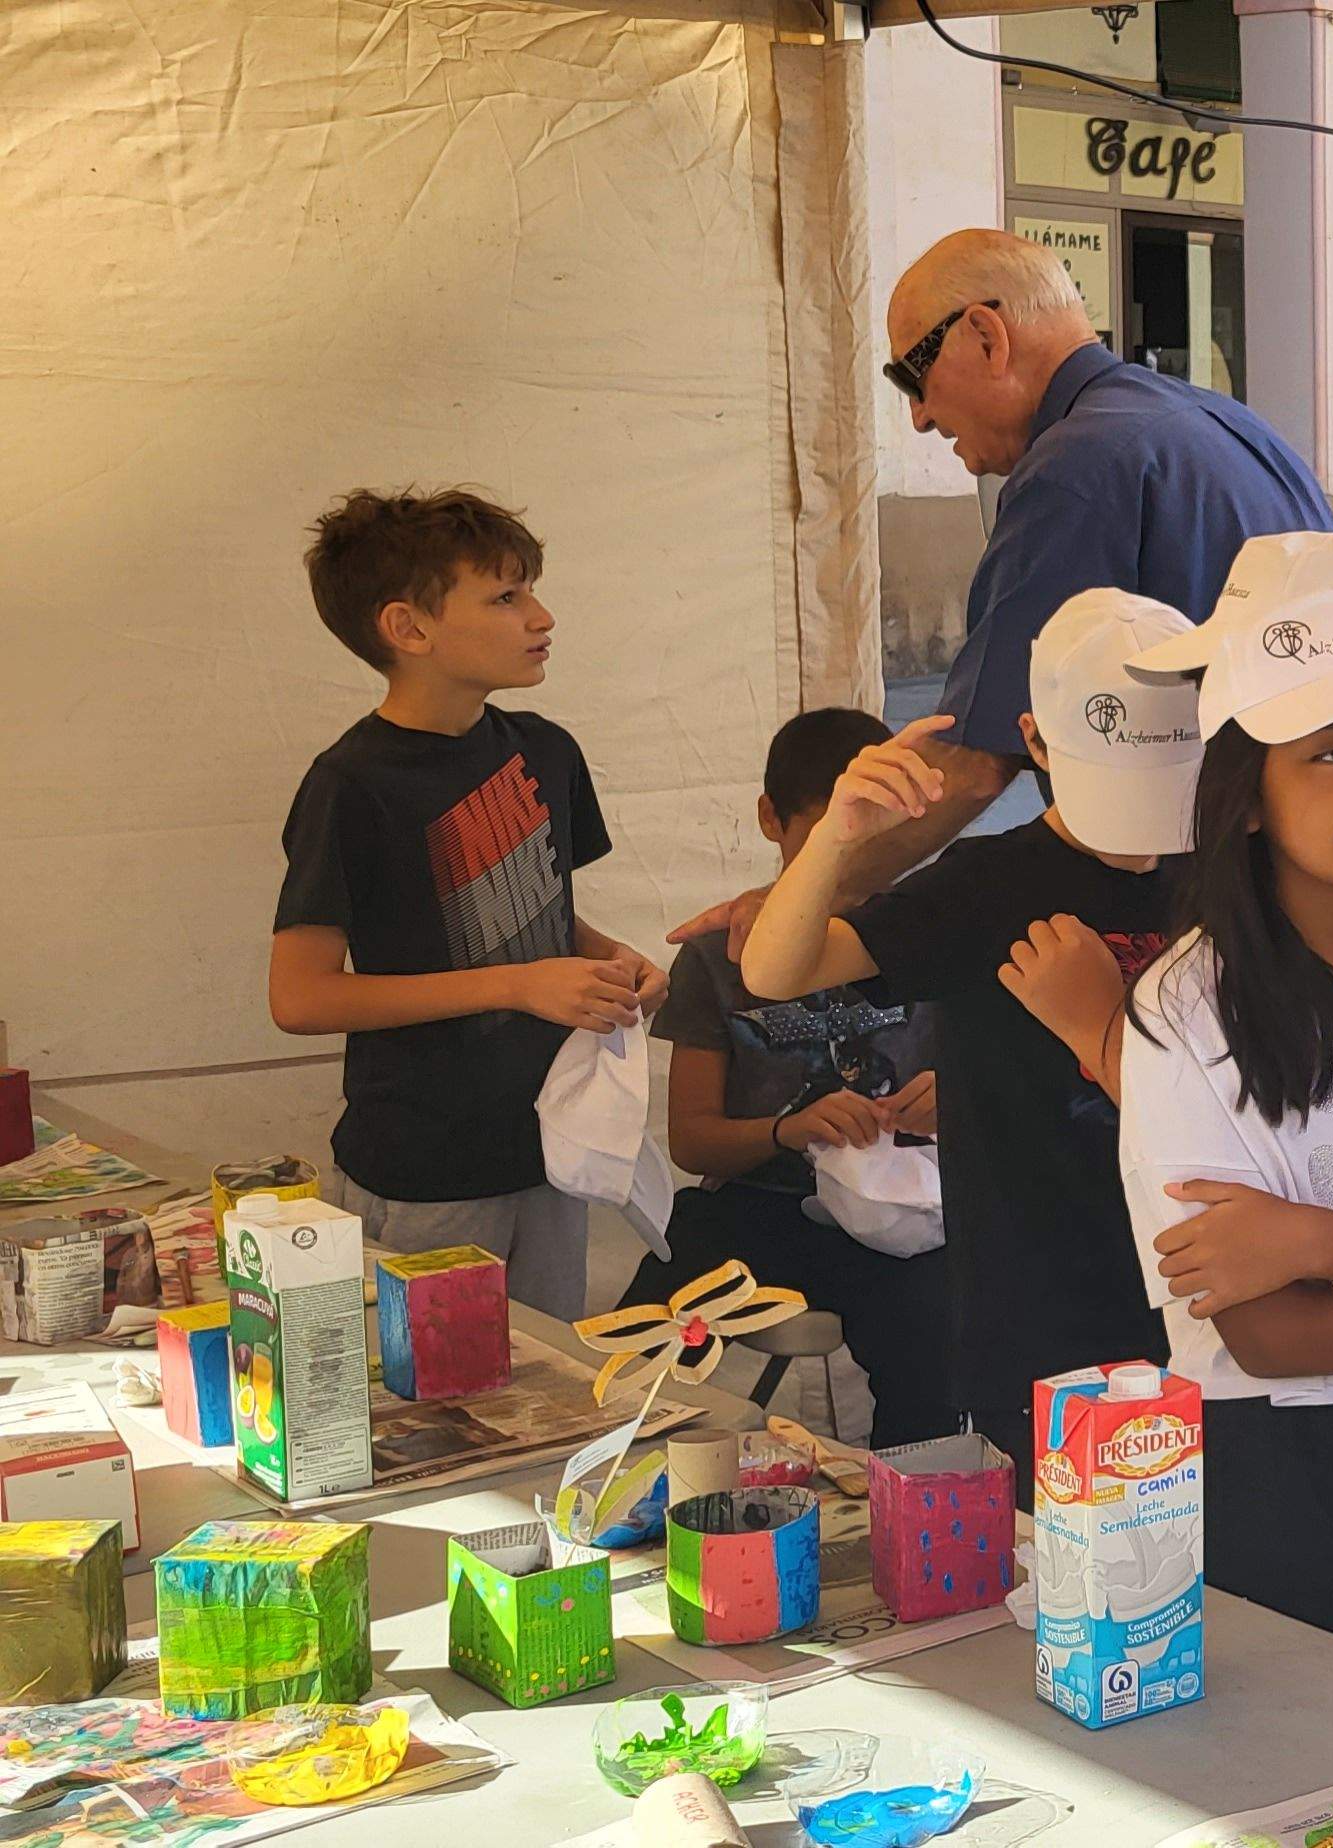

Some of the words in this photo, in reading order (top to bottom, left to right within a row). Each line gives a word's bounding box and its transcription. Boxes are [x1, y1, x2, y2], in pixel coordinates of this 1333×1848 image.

[1115, 729, 1172, 748] Alzheimer
[426, 752, 551, 904] NIKE
[1099, 1423, 1200, 1466] PRÉSIDENT
[1038, 1462, 1082, 1494] PRÉSIDENT
[1099, 1502, 1200, 1536] Semidesnatada
[1136, 1499, 1166, 1514] Leche
[1035, 1517, 1090, 1550] emidesnatada
[1126, 1602, 1194, 1645] SOSTENIBLE
[1127, 1598, 1186, 1633] Compromiso
[1044, 1627, 1087, 1645] SOSTENIBLE
